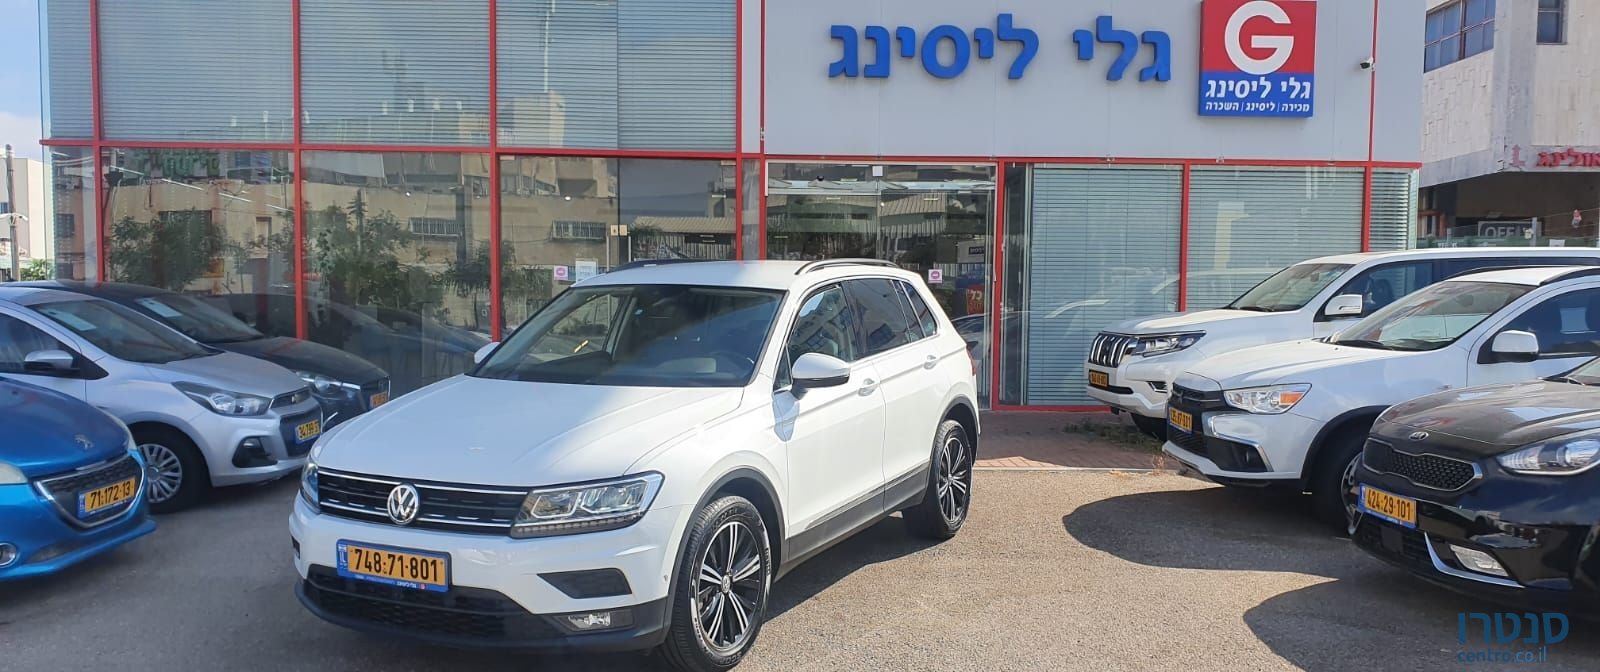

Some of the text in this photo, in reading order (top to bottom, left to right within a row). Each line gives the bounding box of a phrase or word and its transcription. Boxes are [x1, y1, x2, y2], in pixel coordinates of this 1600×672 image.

[828, 13, 1171, 82] גלי ליסינג
[1224, 0, 1295, 75] G
[1205, 76, 1312, 99] גלי ליסינג
[1205, 101, 1310, 113] מכירה ליסינג השכרה
